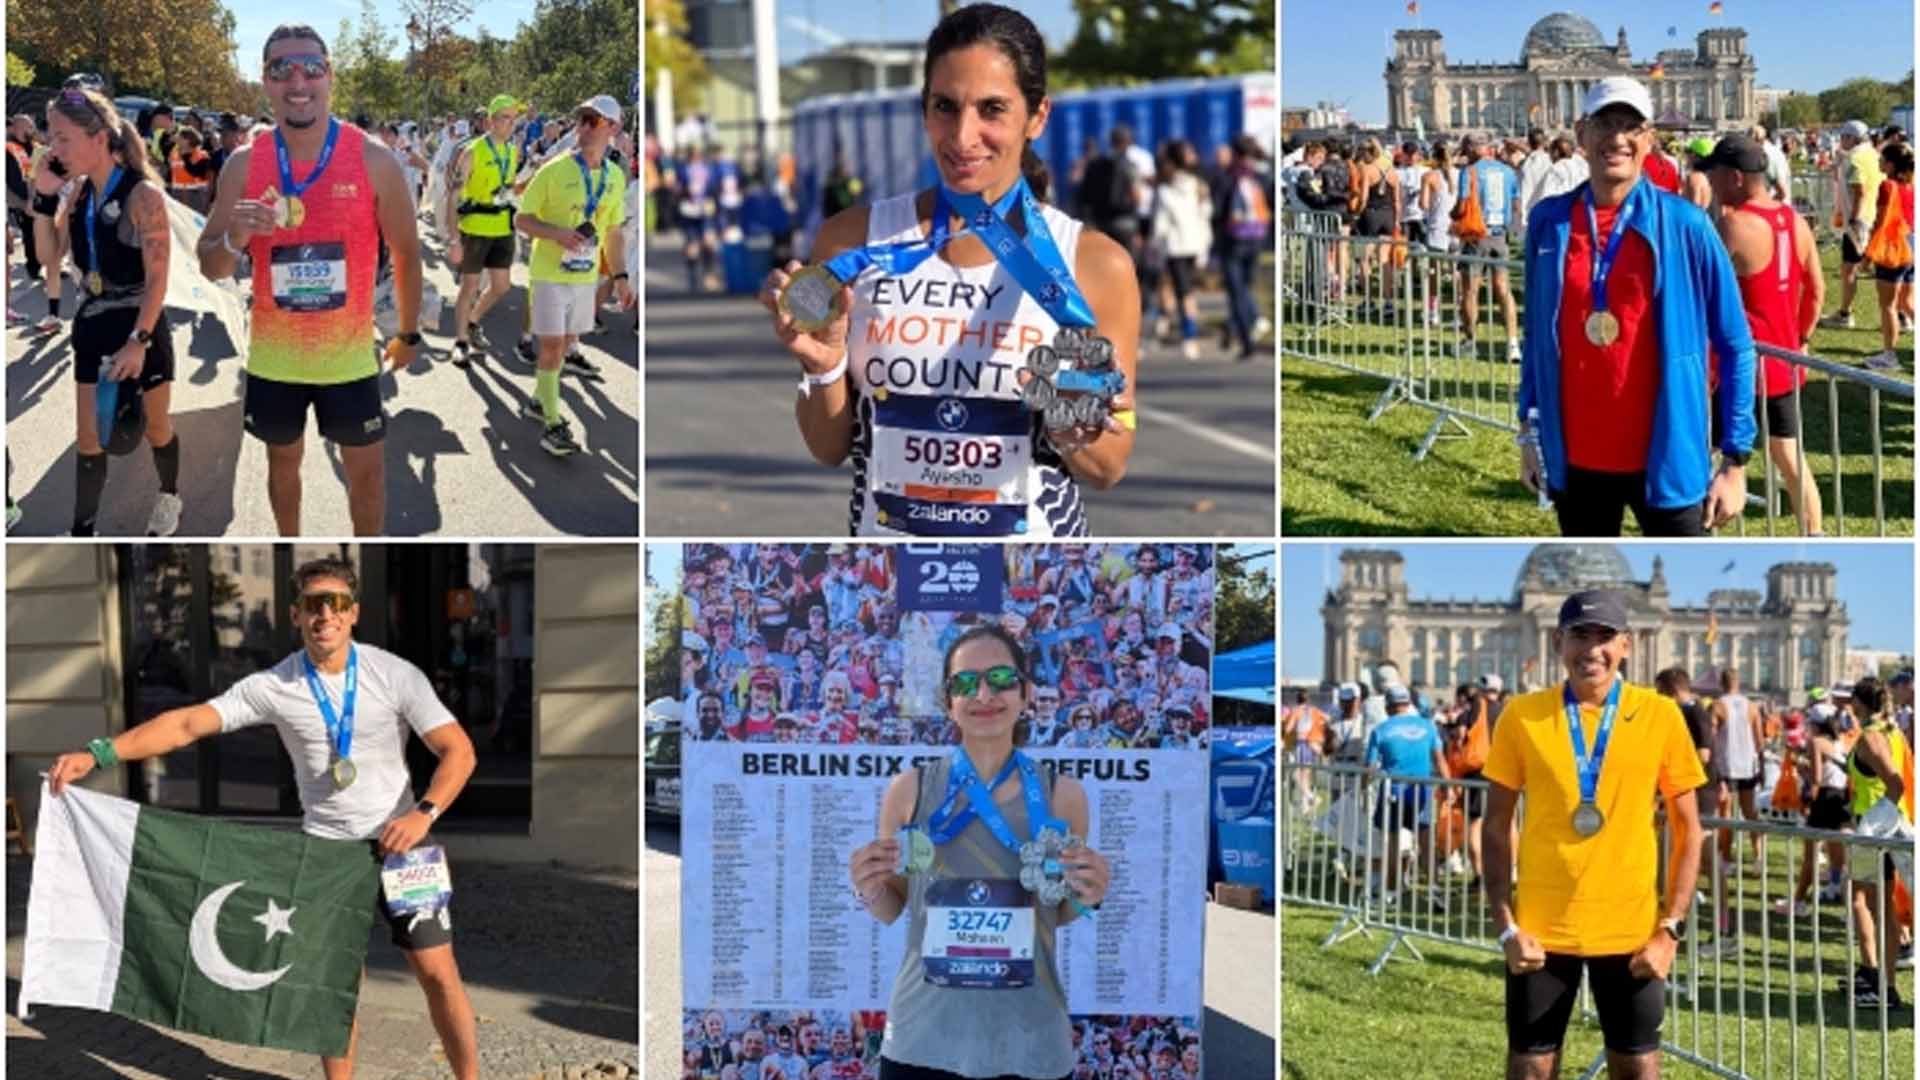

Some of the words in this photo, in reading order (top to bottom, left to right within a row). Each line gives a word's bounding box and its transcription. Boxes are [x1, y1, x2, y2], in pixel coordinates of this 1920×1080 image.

[872, 278, 1003, 309] EVERY
[866, 315, 1043, 353] MOTHER
[904, 435, 1003, 469] 50303
[908, 503, 991, 524] zalando
[742, 753, 849, 777] BERLIN
[855, 753, 904, 777] SIX
[948, 910, 1012, 932] 32747
